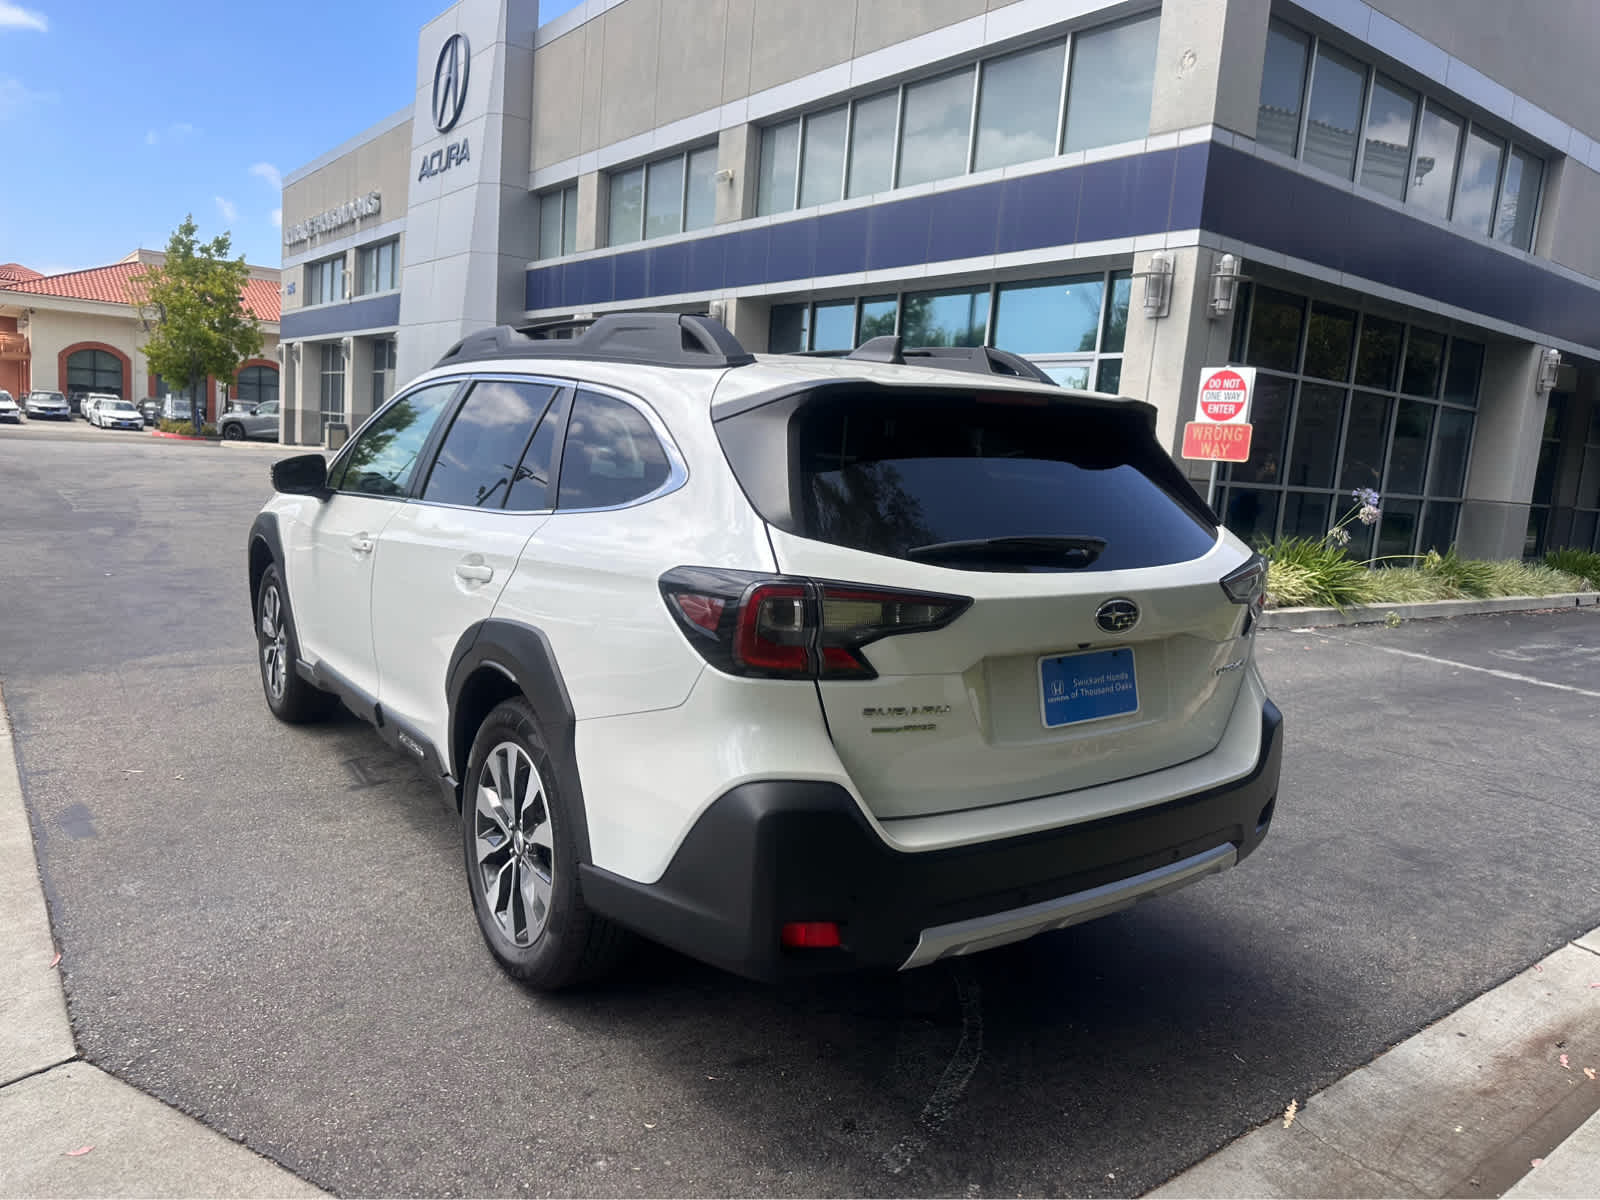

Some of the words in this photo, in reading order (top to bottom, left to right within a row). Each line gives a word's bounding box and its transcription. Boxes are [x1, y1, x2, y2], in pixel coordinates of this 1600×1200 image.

[418, 138, 470, 182] ACURA
[1209, 378, 1221, 388] DO
[1223, 378, 1241, 388] NOT
[1205, 391, 1221, 400] ONE
[1224, 391, 1241, 400] WAY
[1207, 404, 1235, 414] ENTER
[1192, 426, 1243, 441] WRONG
[1200, 442, 1230, 457] WAY
[1071, 689, 1079, 699] of
[1081, 685, 1114, 697] Thousand
